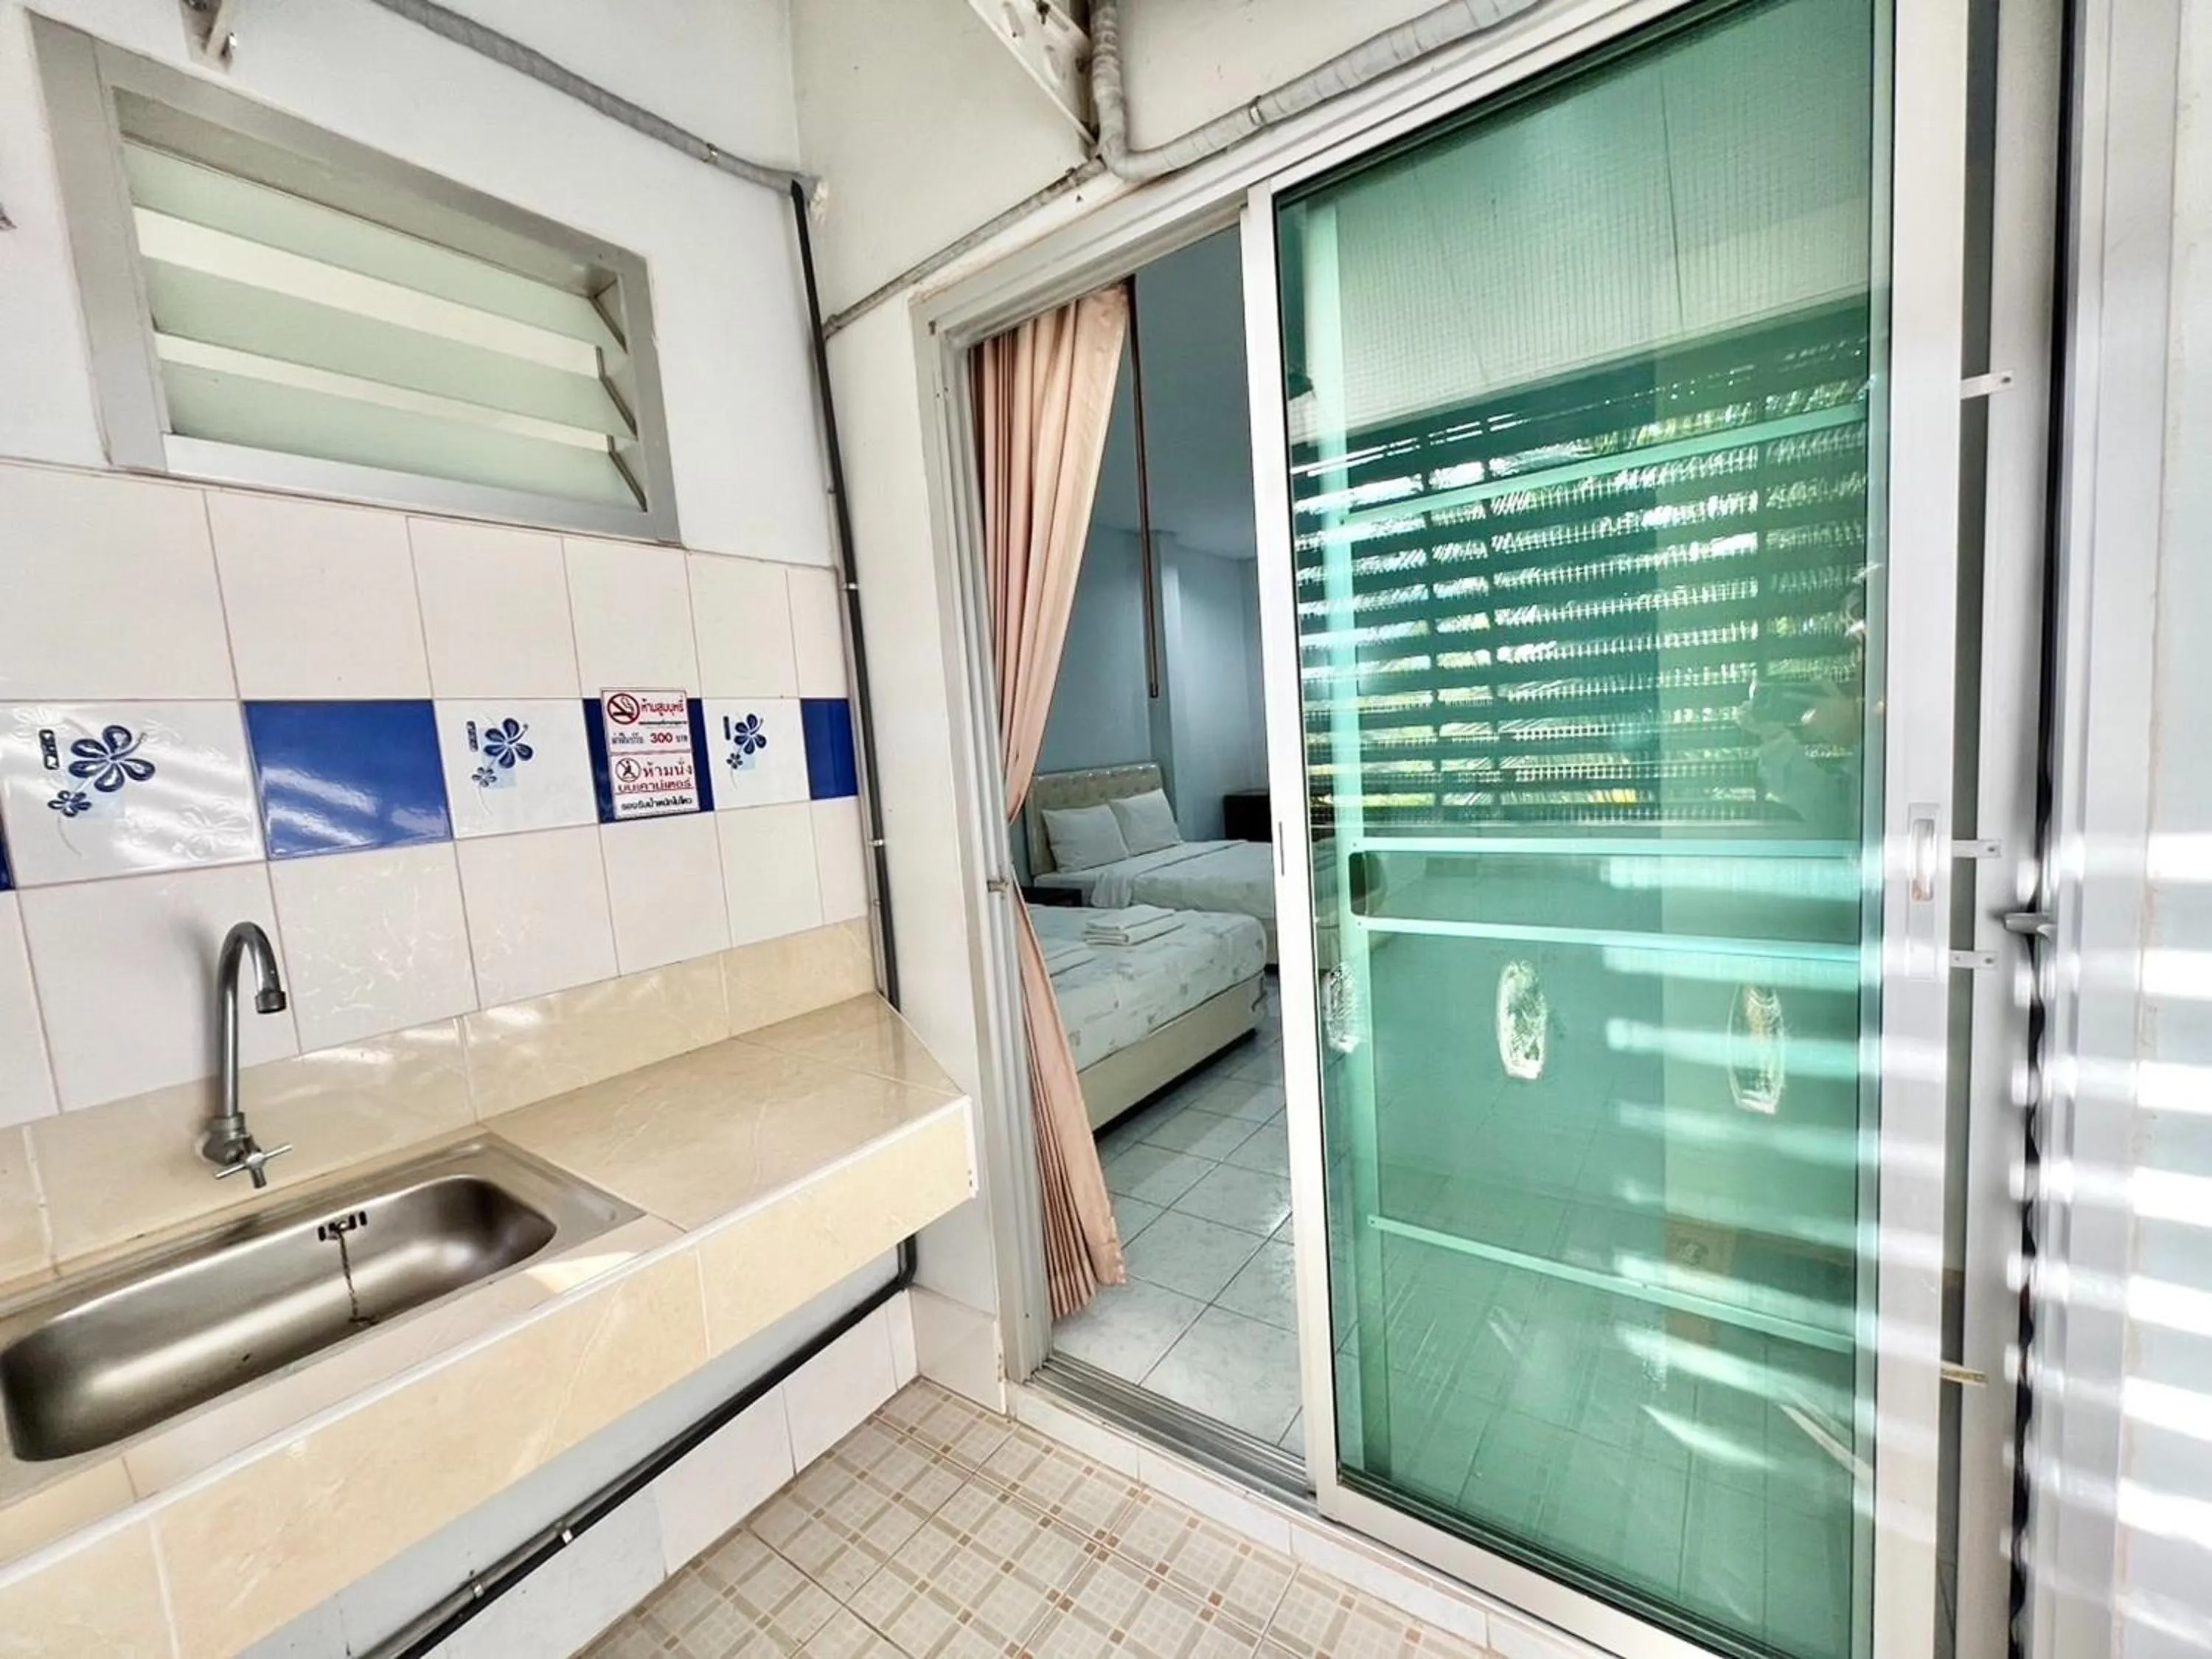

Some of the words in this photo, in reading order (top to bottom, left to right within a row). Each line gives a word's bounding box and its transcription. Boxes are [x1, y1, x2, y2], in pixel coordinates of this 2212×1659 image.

[641, 695, 684, 716] ห้ามสูบบุหรี่
[650, 731, 673, 743] 300
[642, 757, 692, 777] ห้ามนั่ง
